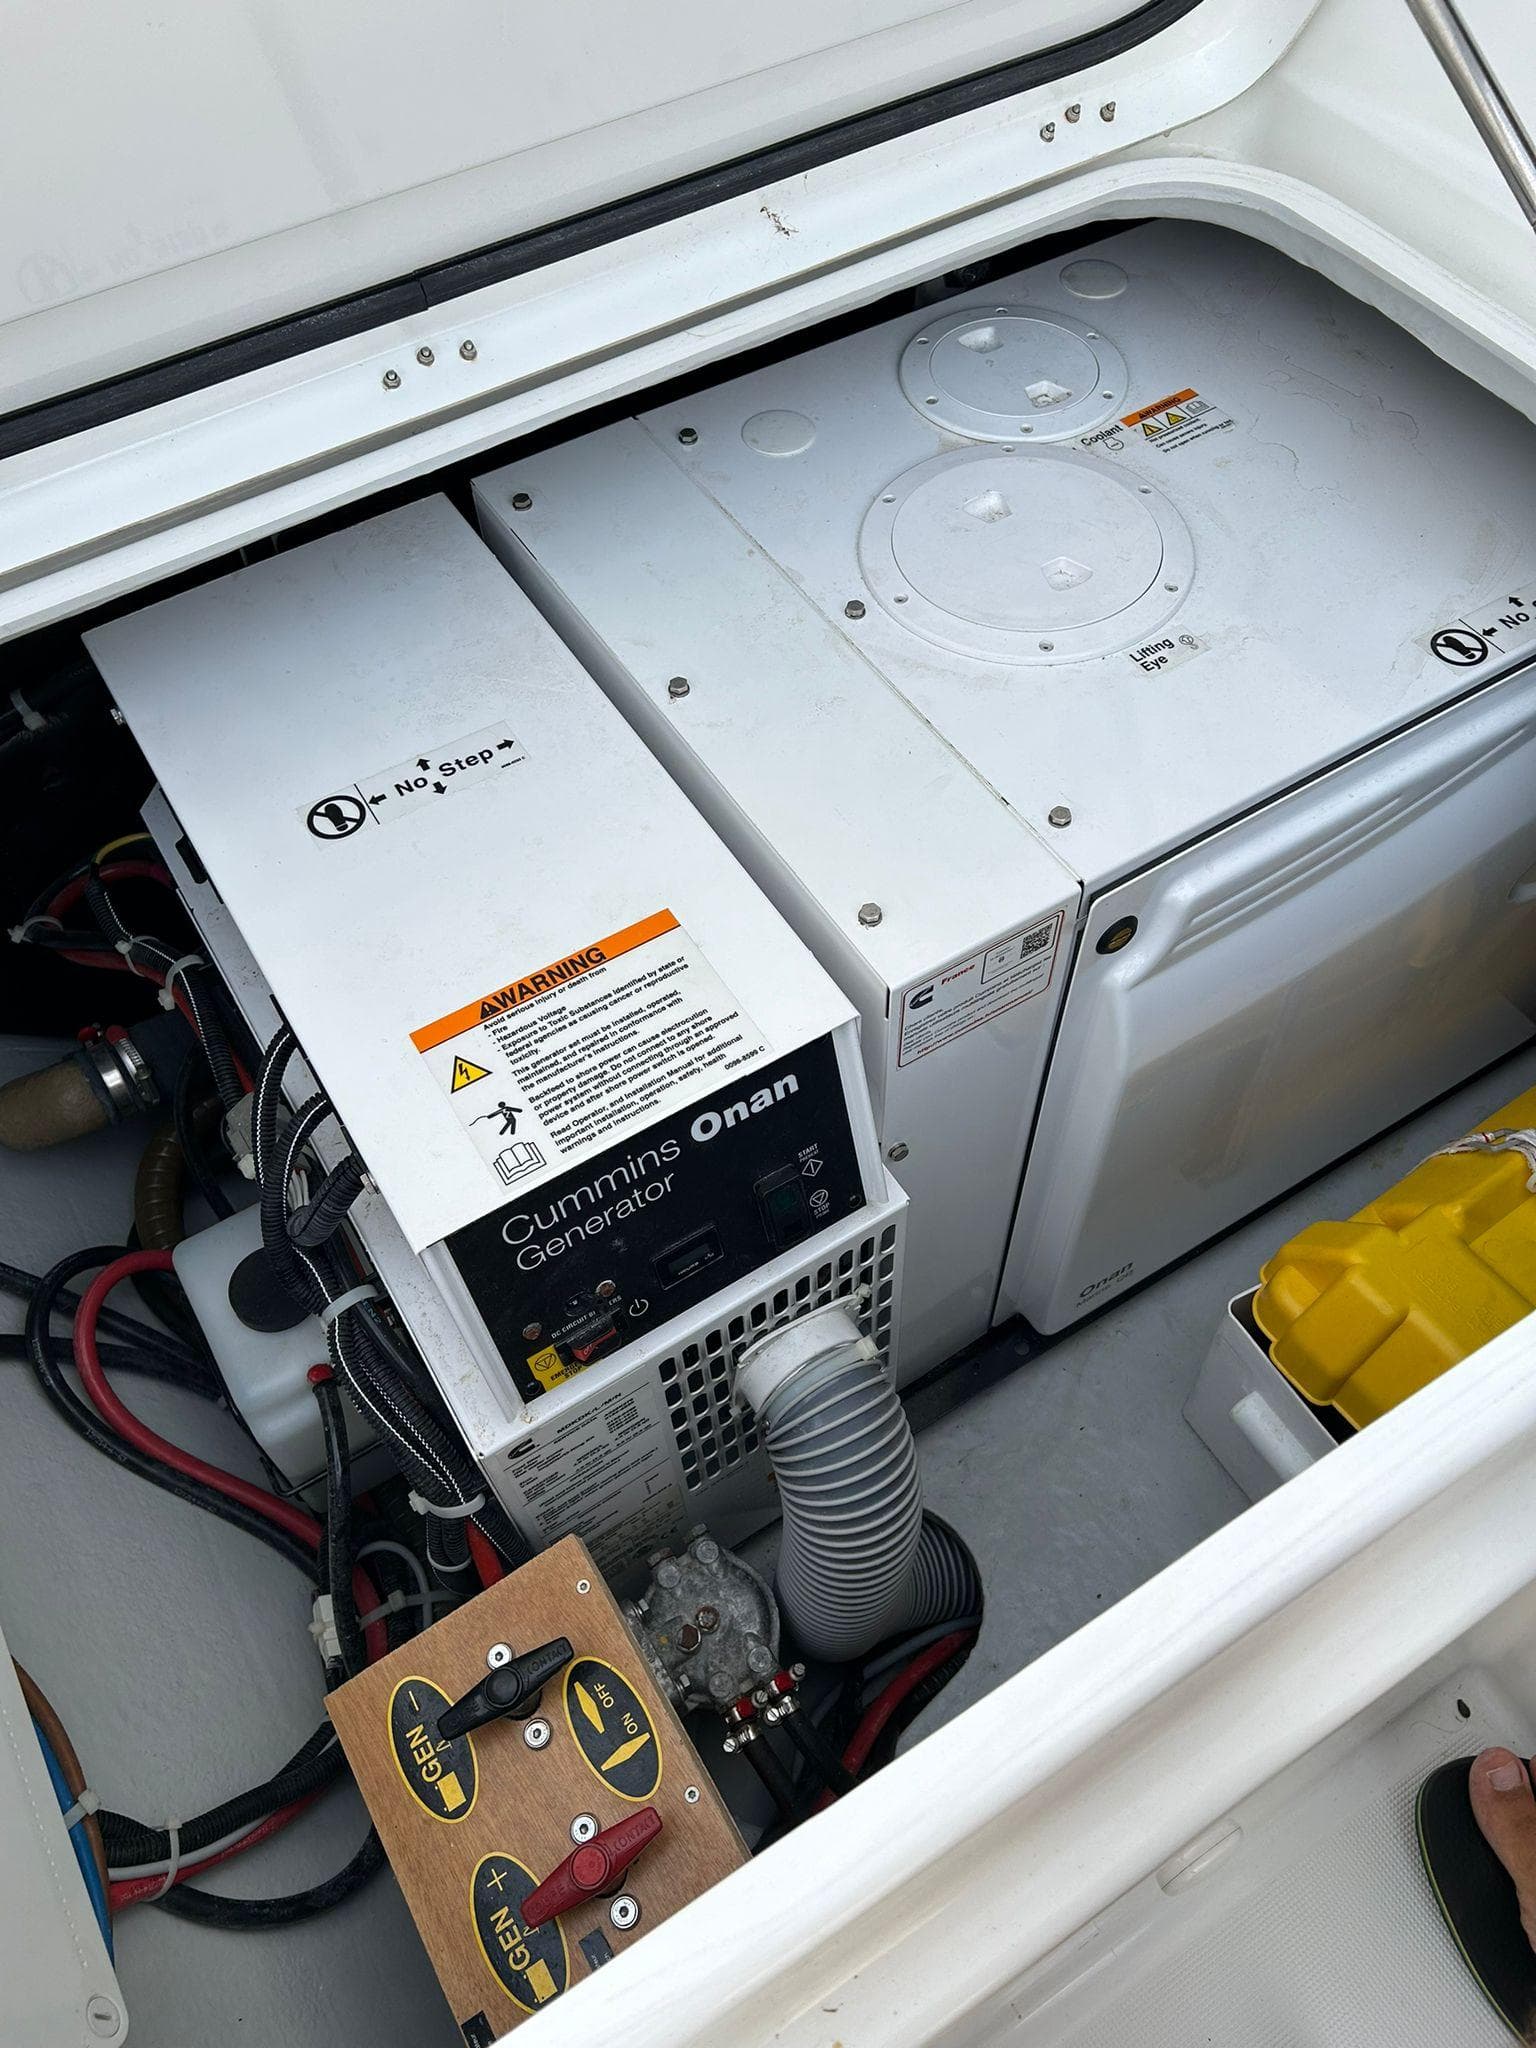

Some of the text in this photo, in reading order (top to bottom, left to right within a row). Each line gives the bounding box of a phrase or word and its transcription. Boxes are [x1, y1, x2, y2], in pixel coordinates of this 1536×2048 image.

[1144, 397, 1181, 416] WARNING
[1081, 424, 1124, 447] Coolant
[1498, 610, 1530, 630] No
[1129, 637, 1175, 663] Lifting
[1141, 654, 1169, 673] Eye
[394, 776, 428, 797] No
[439, 747, 494, 777] Step
[483, 1016, 505, 1030] Avoid
[506, 1002, 534, 1019] serious
[534, 991, 556, 1004] injury
[567, 976, 588, 989] death
[588, 967, 606, 978] from
[493, 947, 606, 1008] WARNING
[941, 964, 975, 985] France
[491, 1025, 507, 1035] Fire
[496, 1006, 566, 1043] Hazardous Voltage
[500, 1029, 538, 1050] Exposure
[546, 1014, 568, 1026] Toxic
[568, 992, 612, 1016] Substances
[612, 974, 647, 994] identified
[646, 969, 656, 977] by
[657, 961, 676, 972] state
[505, 1040, 532, 1057] federal
[533, 1024, 567, 1044] agencies
[578, 1003, 608, 1021] causing
[608, 990, 633, 1006] cancer
[643, 963, 688, 988] reproductive
[509, 1048, 540, 1065] toxicity.
[511, 989, 681, 1076] This generator set must be installed, operated,
[516, 1059, 562, 1084] maintained,
[562, 1050, 577, 1061] and
[577, 1033, 609, 1053] repaired
[618, 1005, 666, 1032] conformance
[666, 997, 683, 1007] with
[528, 1081, 565, 1103] Backfeed
[575, 1065, 597, 1079] shore
[598, 1052, 621, 1068] power
[622, 1045, 637, 1055] can
[637, 1033, 660, 1047] cause
[660, 1008, 708, 1035] electrocution
[521, 1030, 639, 1091] the manufacturer's instructions.
[538, 1102, 562, 1119] power
[563, 1088, 592, 1105] system
[592, 1072, 621, 1090] without
[621, 1050, 664, 1075] connecting
[663, 1035, 693, 1053] through
[704, 1011, 738, 1032] approved
[542, 1110, 569, 1126] device
[569, 1100, 585, 1112] and
[585, 1091, 603, 1104] after
[604, 1080, 627, 1094] shore
[627, 1066, 650, 1083] power
[651, 1053, 677, 1069] switch
[685, 1034, 715, 1051] opened.
[543, 1085, 576, 1106] property
[577, 1069, 610, 1088] damage.
[609, 1062, 622, 1071] Do
[622, 1054, 636, 1064] not
[636, 1038, 667, 1057] connect
[676, 1027, 690, 1037] any
[690, 1016, 712, 1029] shore
[549, 1033, 742, 1138] Read Operator, and Installation Manual for additional
[554, 1053, 726, 1146] important installation, operation, safety, health
[559, 1099, 661, 1153] warnings and instructions.
[798, 1143, 818, 1158] START
[502, 1074, 798, 1243] Cummins Onan
[517, 1173, 673, 1269] Generator
[814, 1202, 830, 1215] STOP
[1079, 1262, 1133, 1298] Onan
[551, 1331, 561, 1339] DC
[562, 1315, 587, 1332] CIRCUIT
[527, 1643, 568, 1675] CONTACT
[594, 1682, 615, 1709] OFF
[621, 1712, 638, 1735] ON
[405, 1724, 443, 1782] GEN
[613, 1814, 656, 1854] CONTACT
[490, 1905, 531, 1971] GEN
